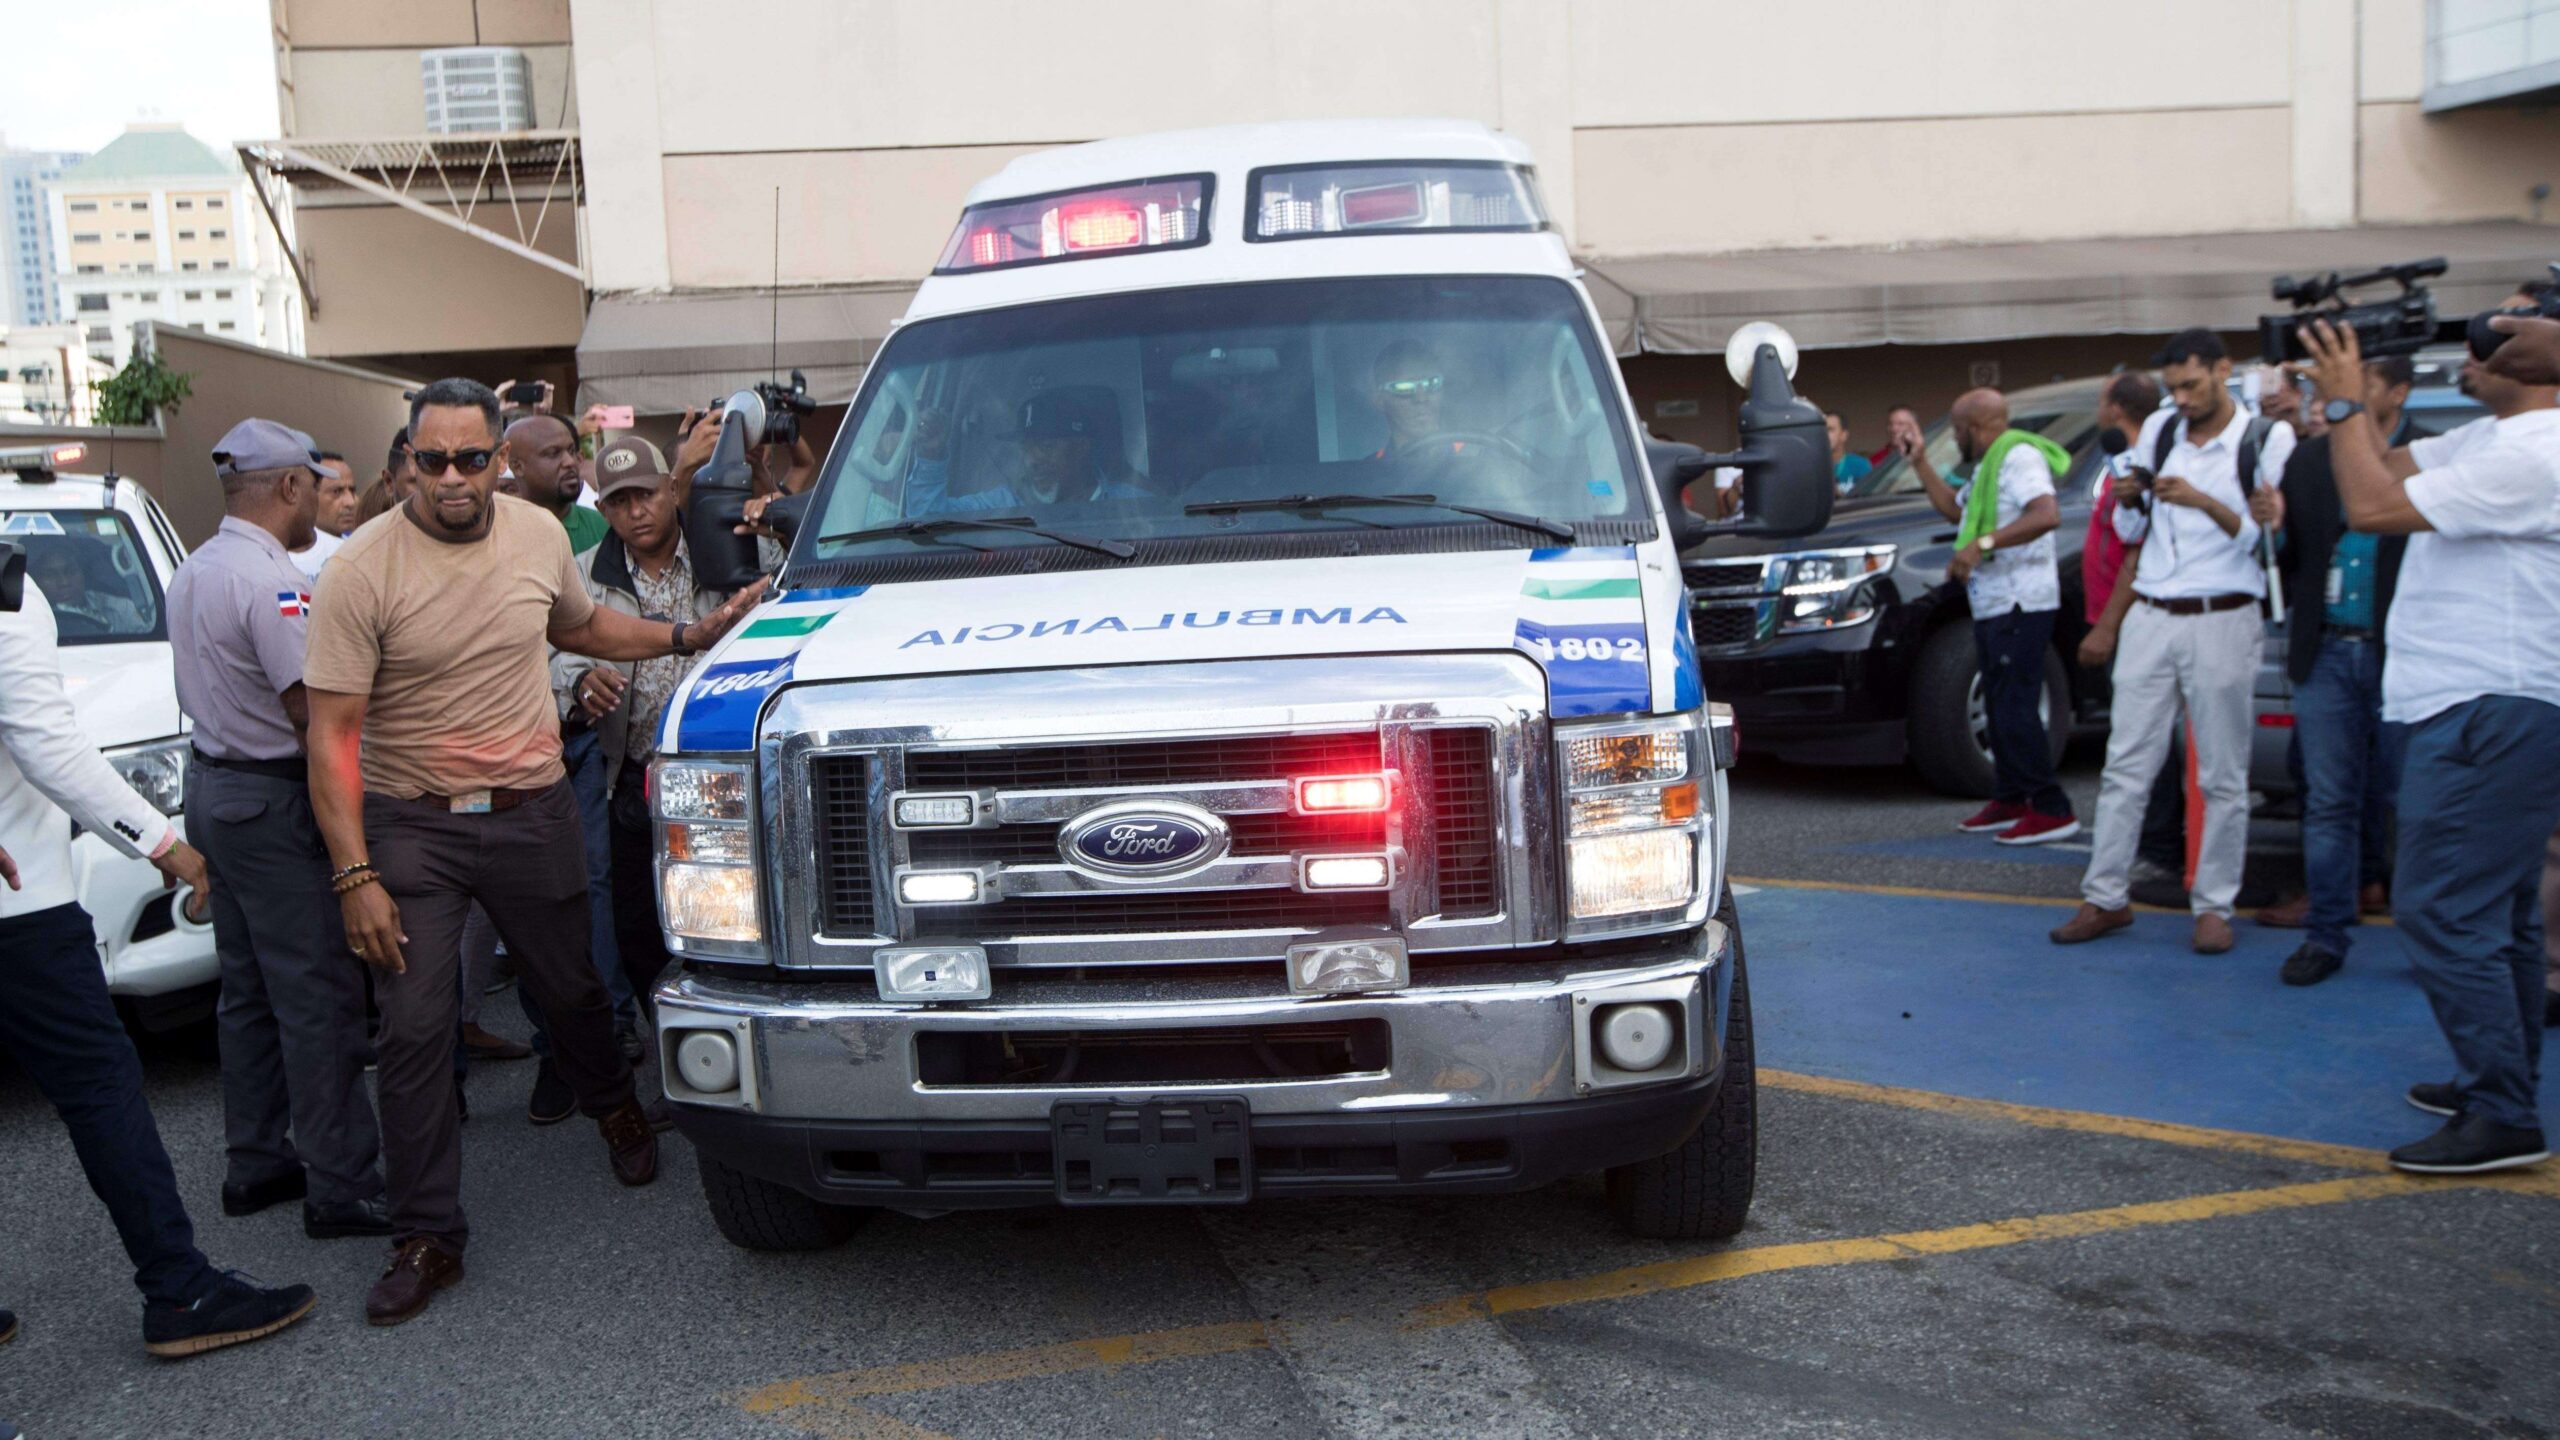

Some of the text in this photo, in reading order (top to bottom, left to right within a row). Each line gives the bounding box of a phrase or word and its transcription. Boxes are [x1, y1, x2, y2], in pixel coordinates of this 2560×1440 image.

[607, 453, 631, 468] OBX
[1535, 637, 1644, 662] 1802
[1103, 824, 1177, 856] Ford
